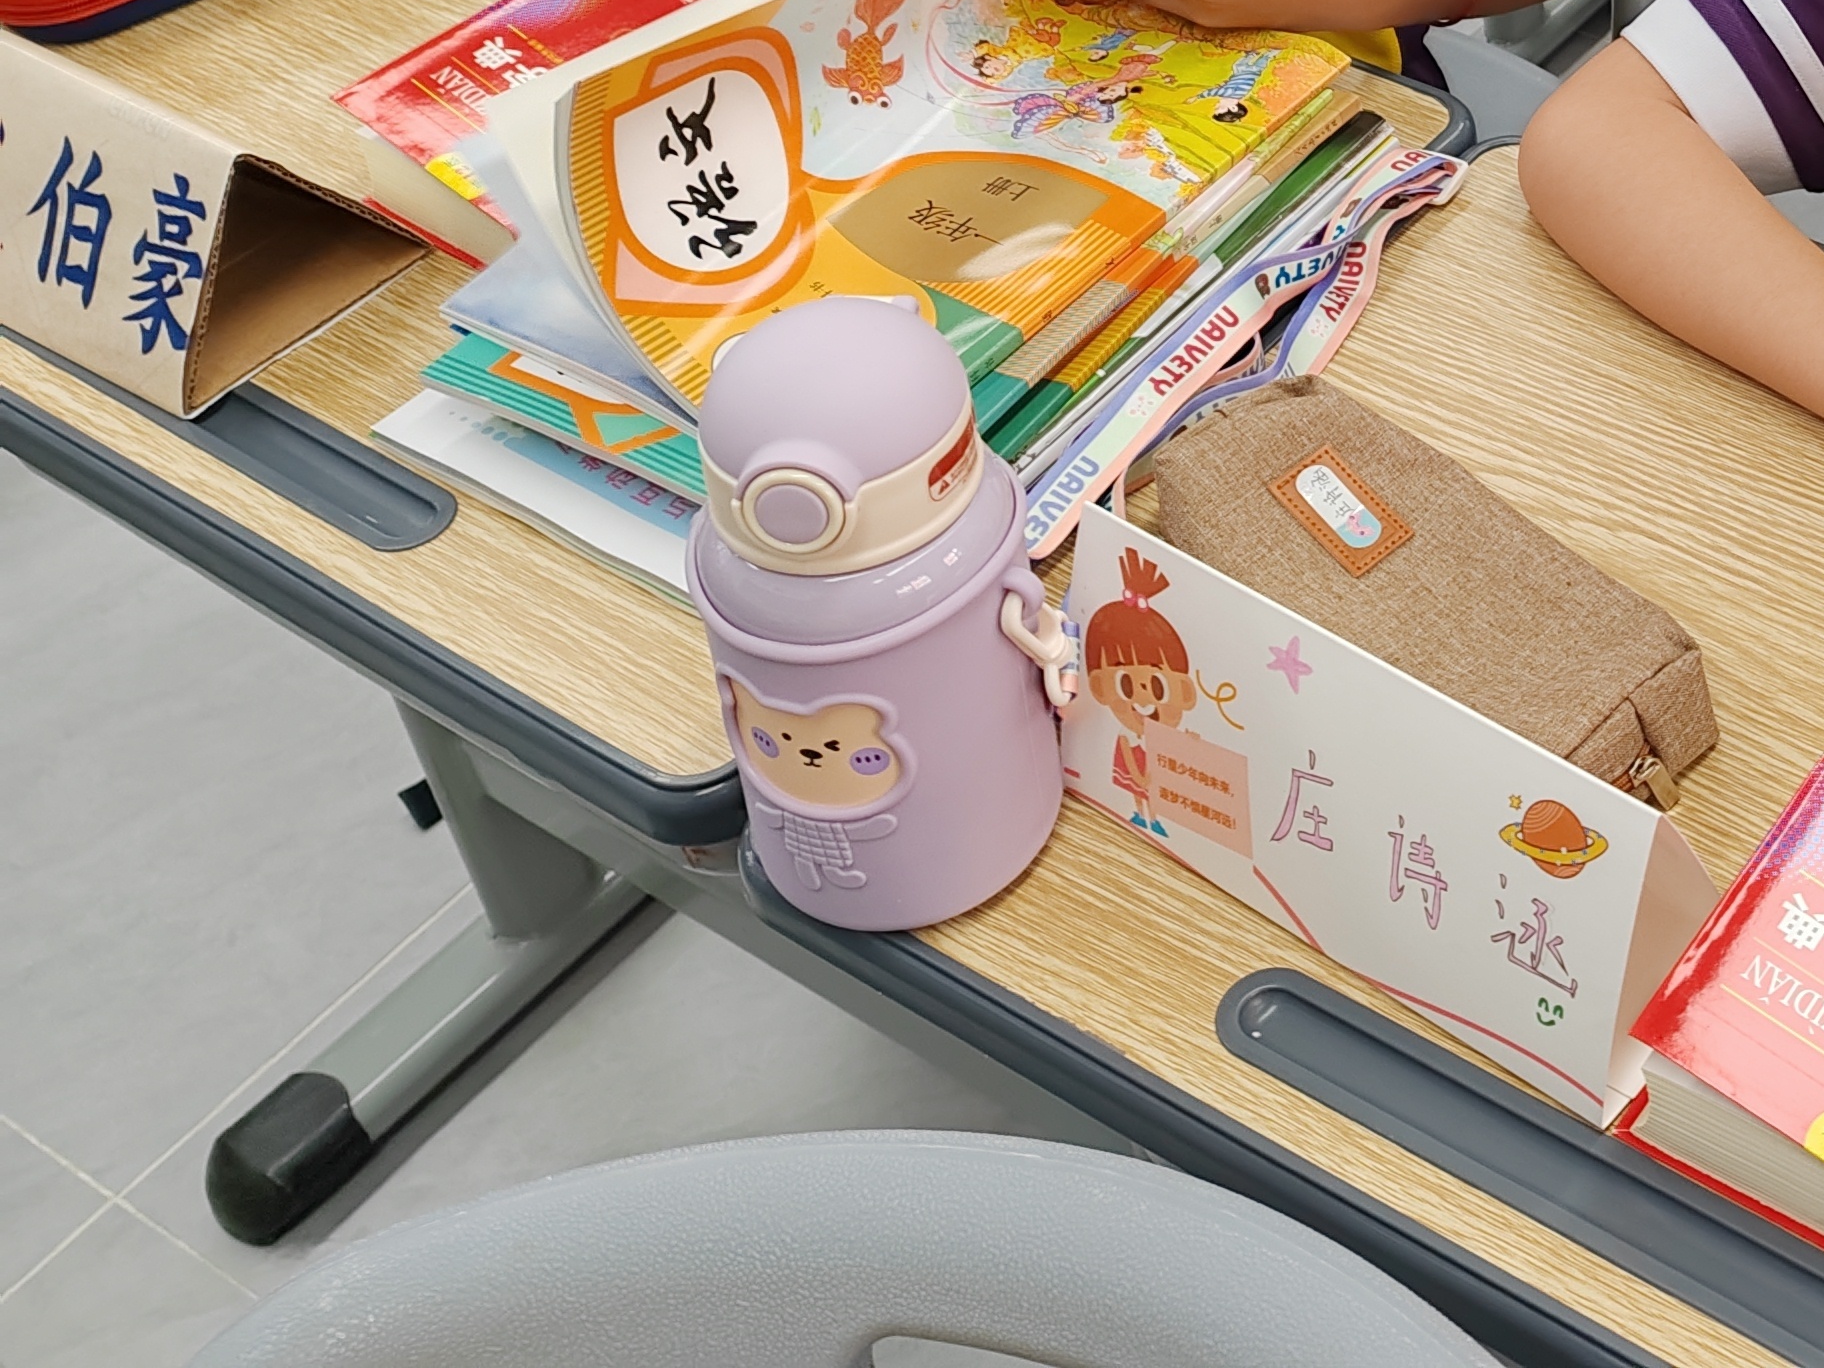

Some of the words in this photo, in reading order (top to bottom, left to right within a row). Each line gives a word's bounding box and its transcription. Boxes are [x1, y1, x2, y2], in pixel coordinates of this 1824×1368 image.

[658, 76, 758, 260] 语文
[981, 176, 1041, 203] 上册
[0, 122, 207, 355] 伯豪
[908, 200, 1003, 246] 一年级
[1149, 305, 1240, 397] NAIVETY
